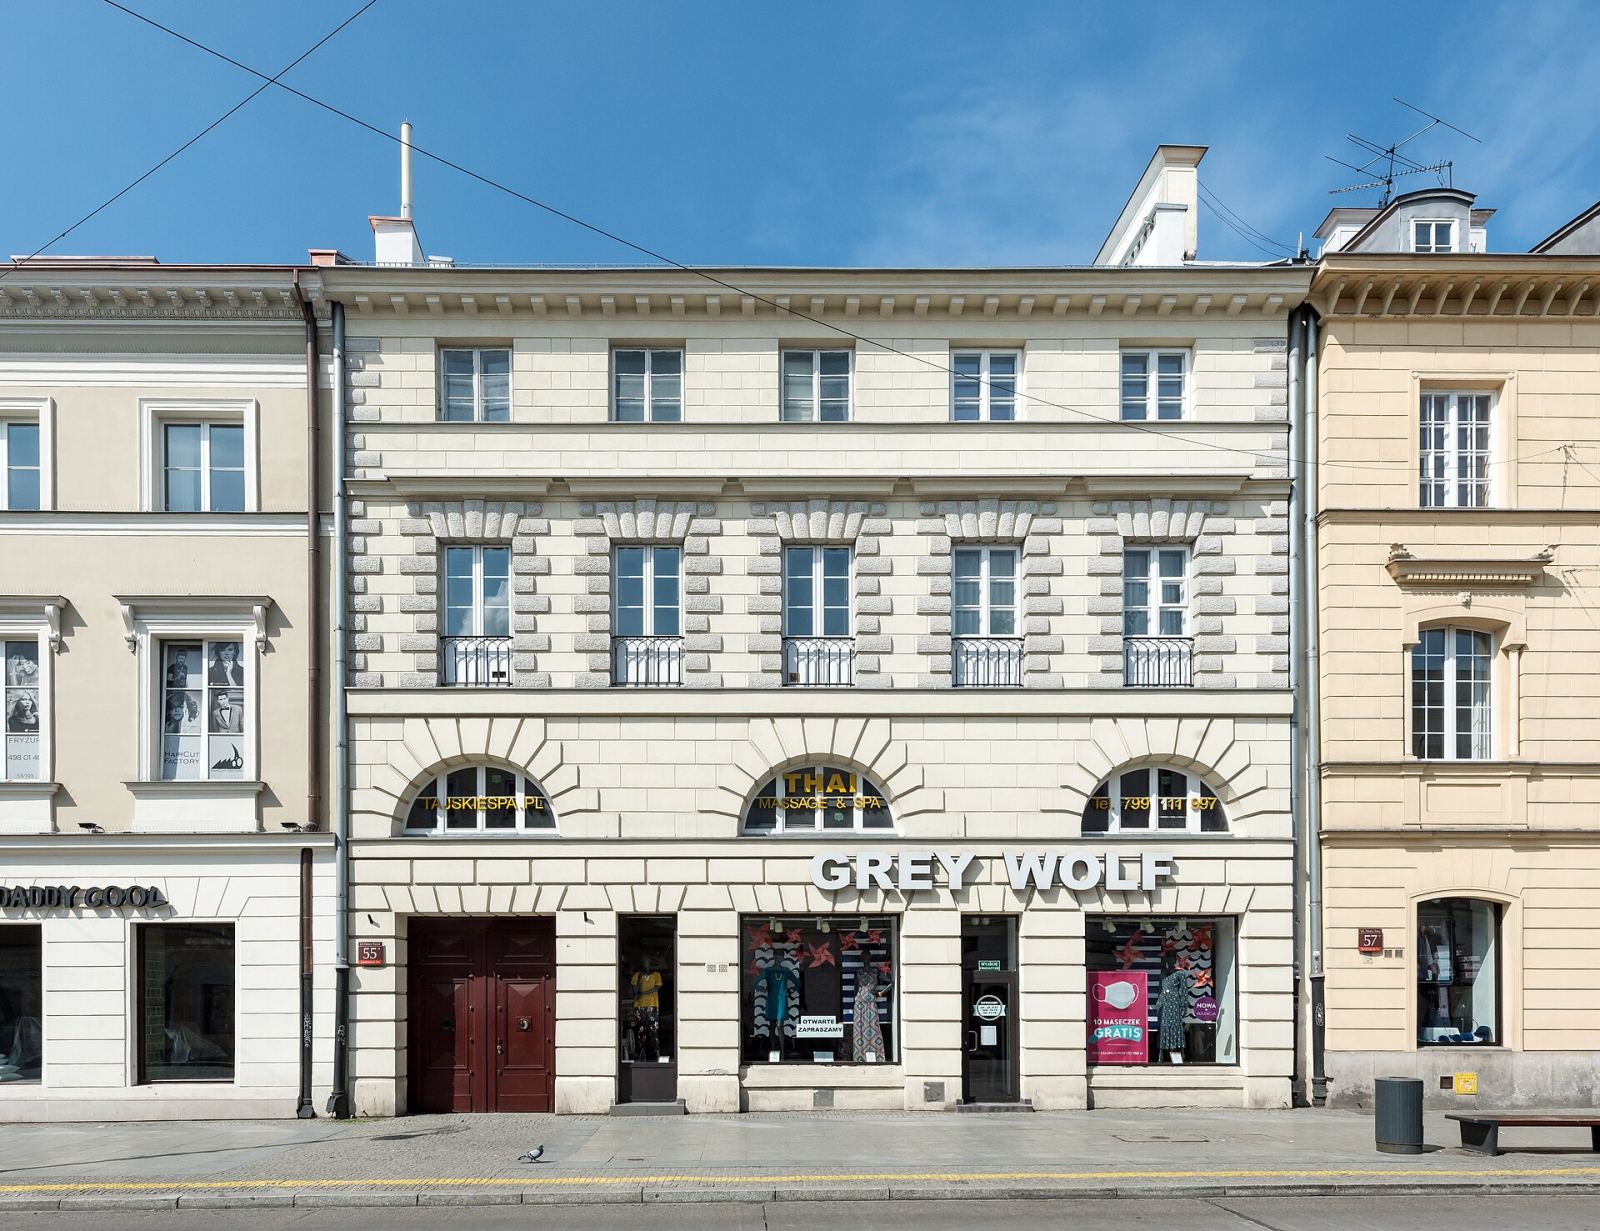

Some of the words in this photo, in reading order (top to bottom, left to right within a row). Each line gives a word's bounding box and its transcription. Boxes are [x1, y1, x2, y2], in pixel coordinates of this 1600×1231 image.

[784, 773, 857, 793] THAI
[760, 797, 828, 809] MASSAGE
[836, 797, 846, 809] &
[854, 796, 880, 809] SPA
[1123, 797, 1150, 810] 799
[1161, 798, 1182, 810] 111
[1191, 797, 1217, 810] 997
[809, 851, 977, 891] GREY
[1002, 851, 1175, 891] WOLF
[0, 885, 81, 908] DADDY
[84, 885, 169, 908] COOL
[1363, 934, 1377, 946] 57
[362, 947, 377, 959] 55
[1094, 1027, 1141, 1038] GRATIS
